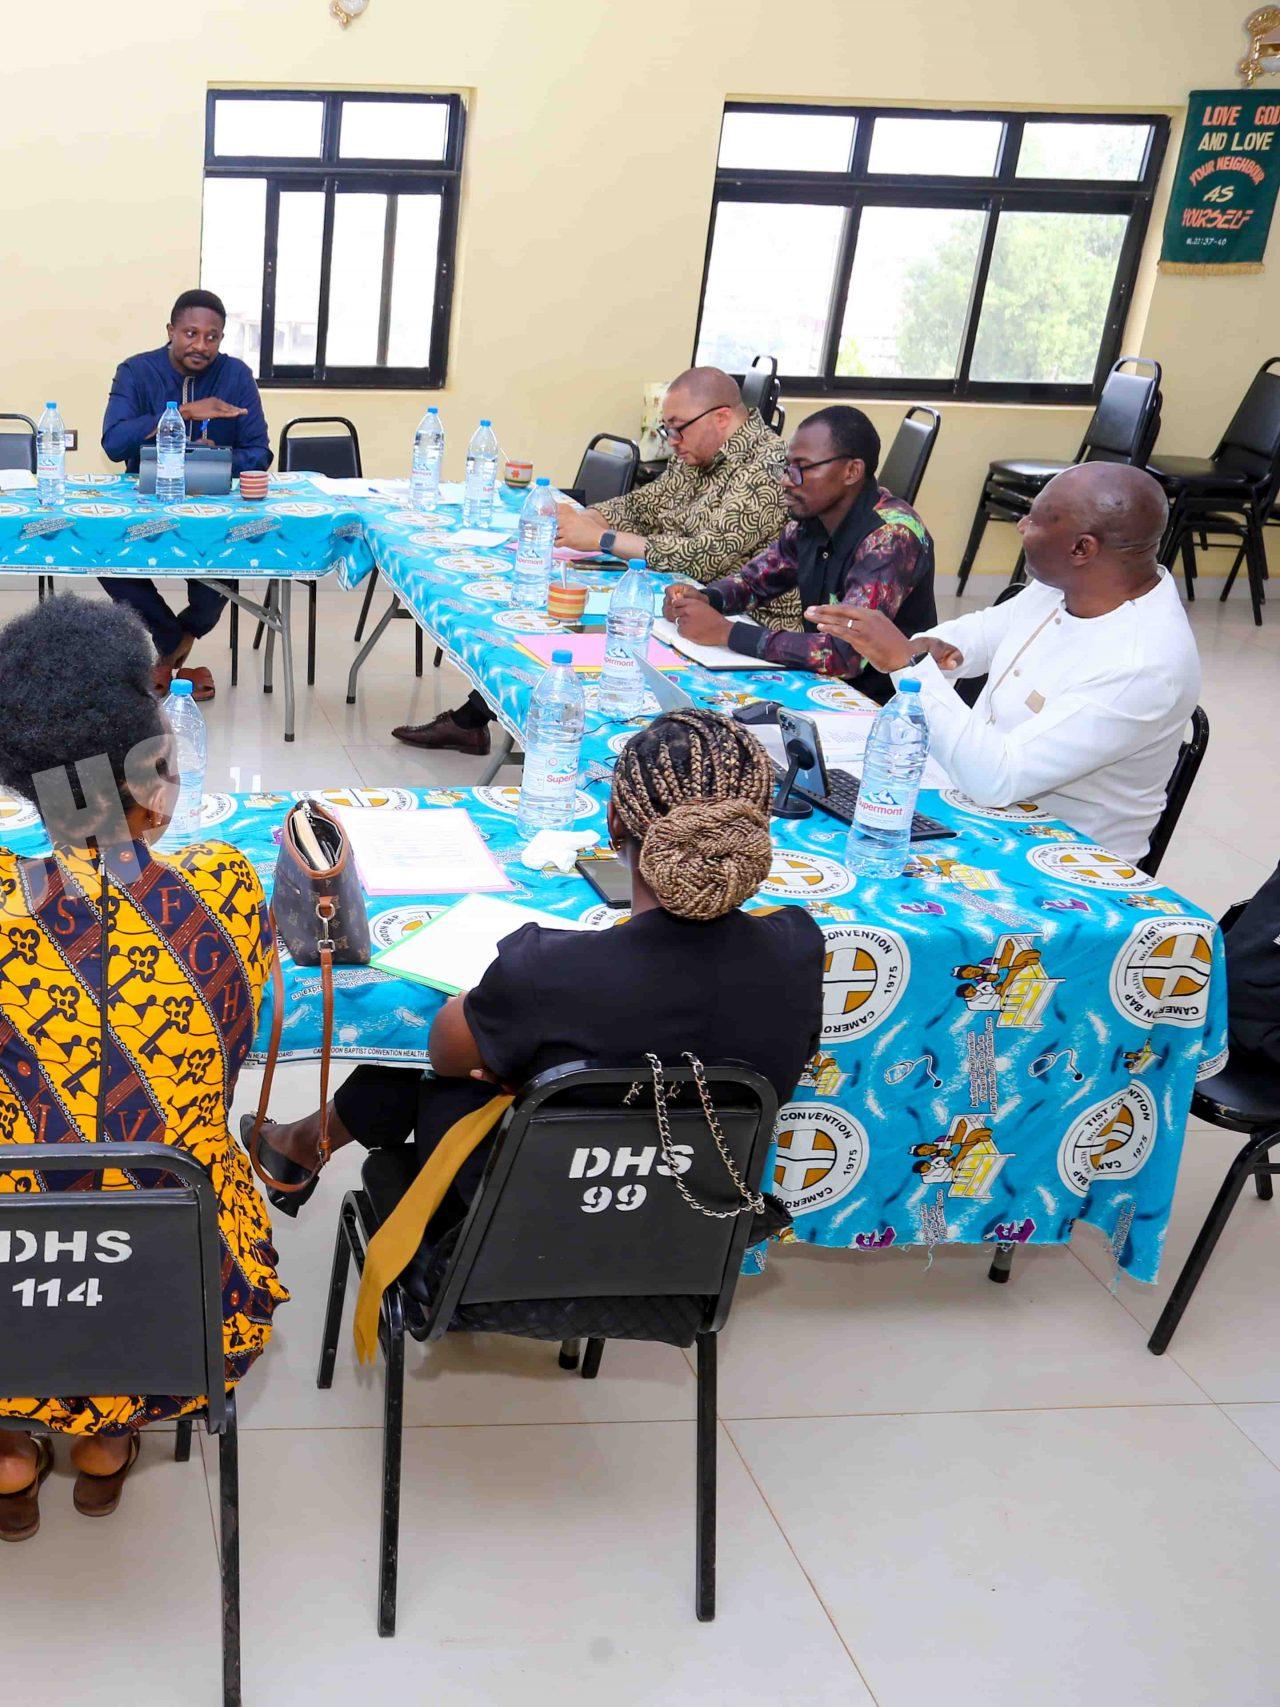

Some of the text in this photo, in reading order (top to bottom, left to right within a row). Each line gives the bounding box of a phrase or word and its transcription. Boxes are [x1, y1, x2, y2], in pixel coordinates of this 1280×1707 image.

[1202, 106, 1243, 126] LOVE
[1198, 131, 1275, 151] AND LOVE
[1188, 156, 1266, 187] YOUR NEIGHBOUR
[1203, 185, 1235, 202] AS
[1181, 208, 1254, 230] YOURSELF
[884, 965, 898, 995] 1975
[823, 1010, 875, 1034] CAMERO
[344, 1047, 367, 1055] BAPTIST
[367, 1048, 402, 1056] CONVENTION
[1085, 1106, 1108, 1127] TIST
[780, 1111, 858, 1176] CONVENTION 1975
[568, 1144, 695, 1180] DHS
[580, 1184, 648, 1213] 99
[12, 1277, 103, 1307] 114
